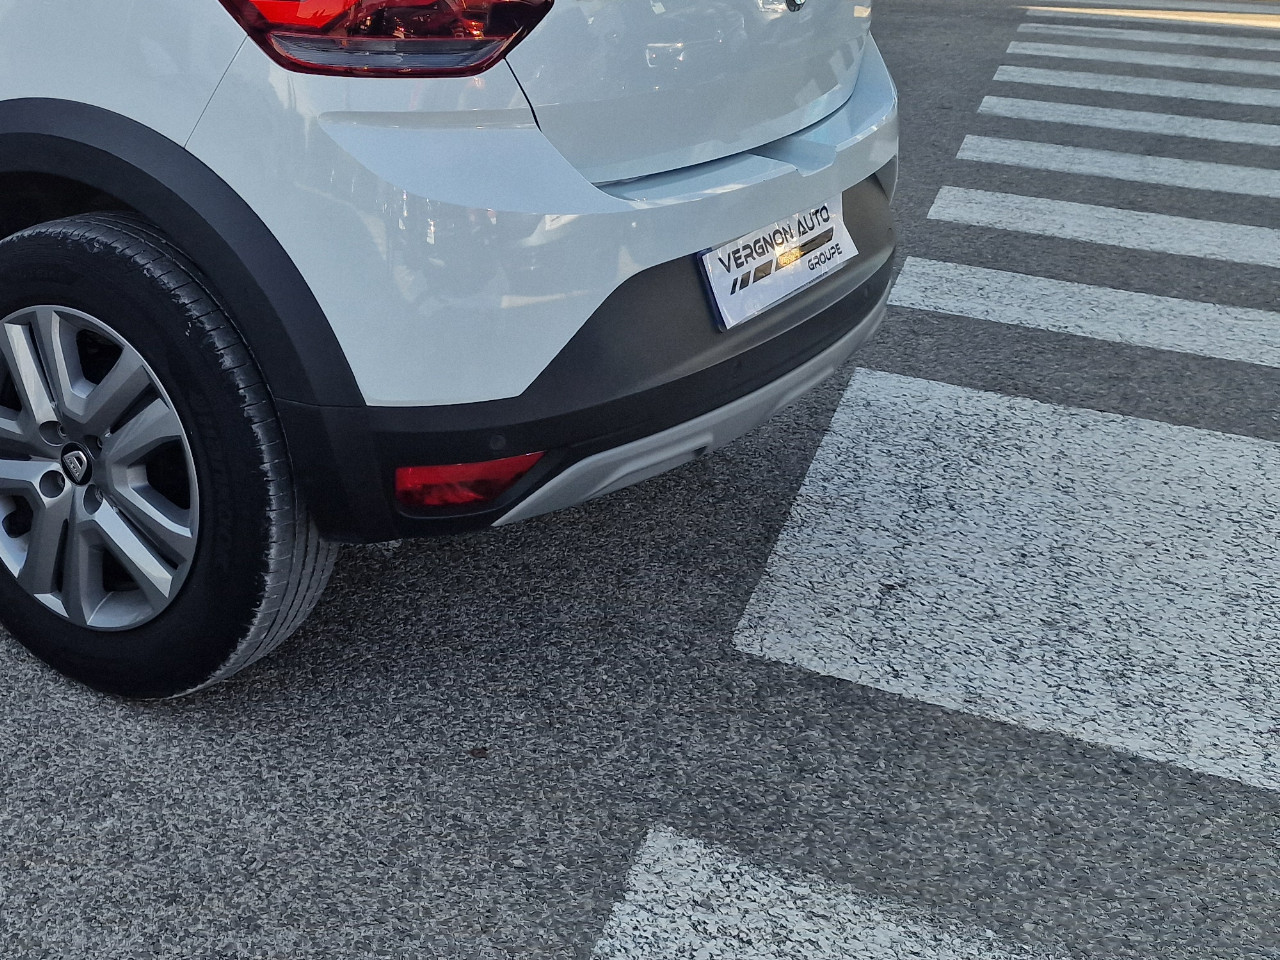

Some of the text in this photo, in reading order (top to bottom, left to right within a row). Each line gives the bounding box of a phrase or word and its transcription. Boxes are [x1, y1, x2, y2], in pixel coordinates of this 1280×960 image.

[718, 205, 831, 274] VERGNON AUTO
[807, 242, 843, 271] GROUPE
